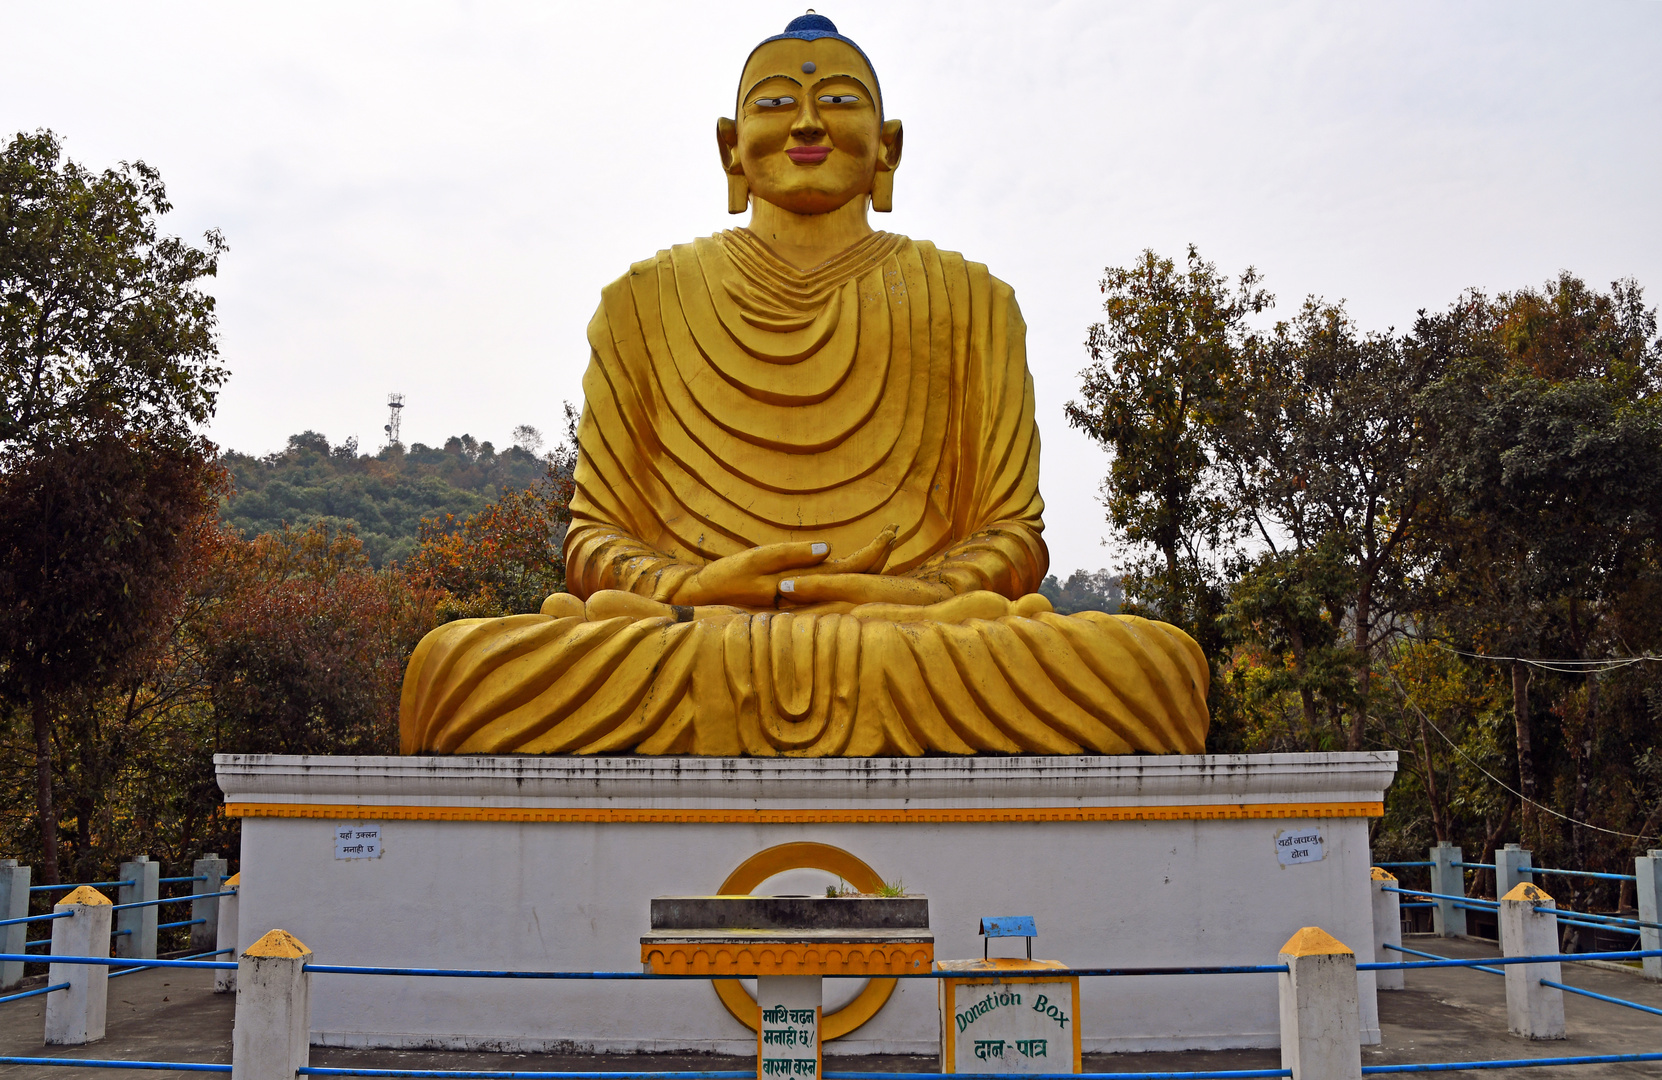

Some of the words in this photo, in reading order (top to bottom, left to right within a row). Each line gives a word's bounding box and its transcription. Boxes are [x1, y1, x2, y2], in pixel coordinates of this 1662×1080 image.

[1278, 836, 1292, 846] यहाँ
[343, 844, 364, 854] मनाही
[1291, 849, 1308, 858] होला
[762, 1004, 788, 1024] माथि
[955, 991, 1022, 1033] Donation
[1032, 994, 1070, 1029] Box
[764, 1026, 797, 1049] मनाही
